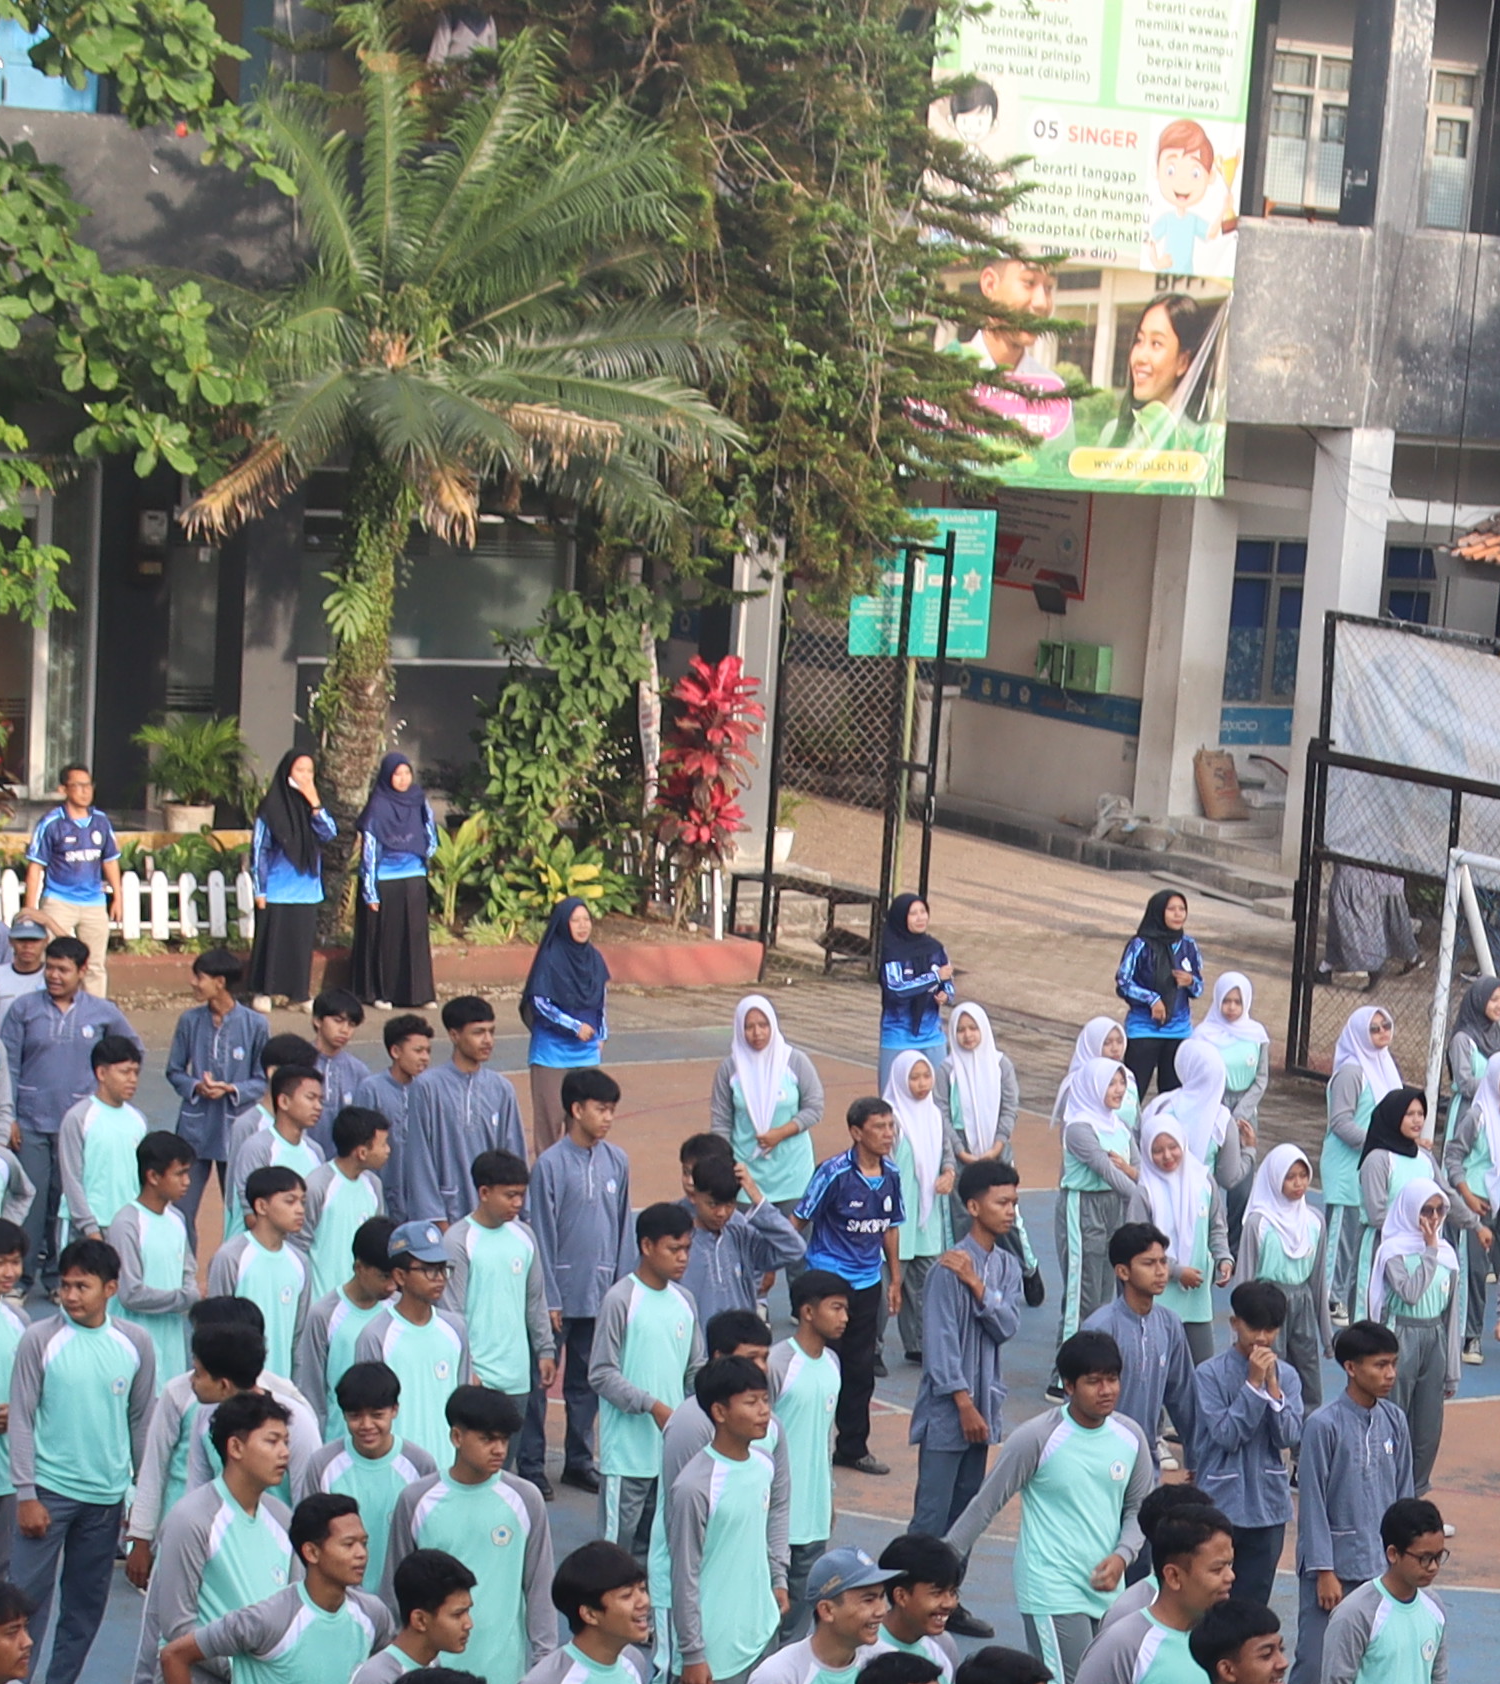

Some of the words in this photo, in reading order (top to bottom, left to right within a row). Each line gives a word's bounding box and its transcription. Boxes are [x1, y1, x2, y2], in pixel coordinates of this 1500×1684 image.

[981, 24, 1062, 46] berintegritas,
[1066, 34, 1088, 46] dan
[1135, 17, 1185, 34] memiliki
[986, 43, 1038, 59] memiliki
[1041, 50, 1082, 65] prinsip
[1168, 39, 1189, 52] dan
[973, 61, 1004, 75] yang
[1008, 64, 1035, 78] kuat
[1038, 67, 1091, 85] (disiplin)
[1147, 55, 1193, 73] berpikir
[1195, 60, 1222, 75] kritis
[1136, 72, 1182, 89] (pandai
[1144, 91, 1185, 107] mental
[1187, 96, 1220, 111] juara)
[1034, 119, 1058, 139] 05
[1068, 125, 1138, 149] SINGER
[1033, 158, 1077, 177] berarti
[1082, 165, 1136, 184] tanggap
[1073, 204, 1097, 218] dan
[1101, 210, 1150, 224] mampu
[1007, 219, 1086, 237] beradaptasi
[1090, 246, 1118, 262] diri)
